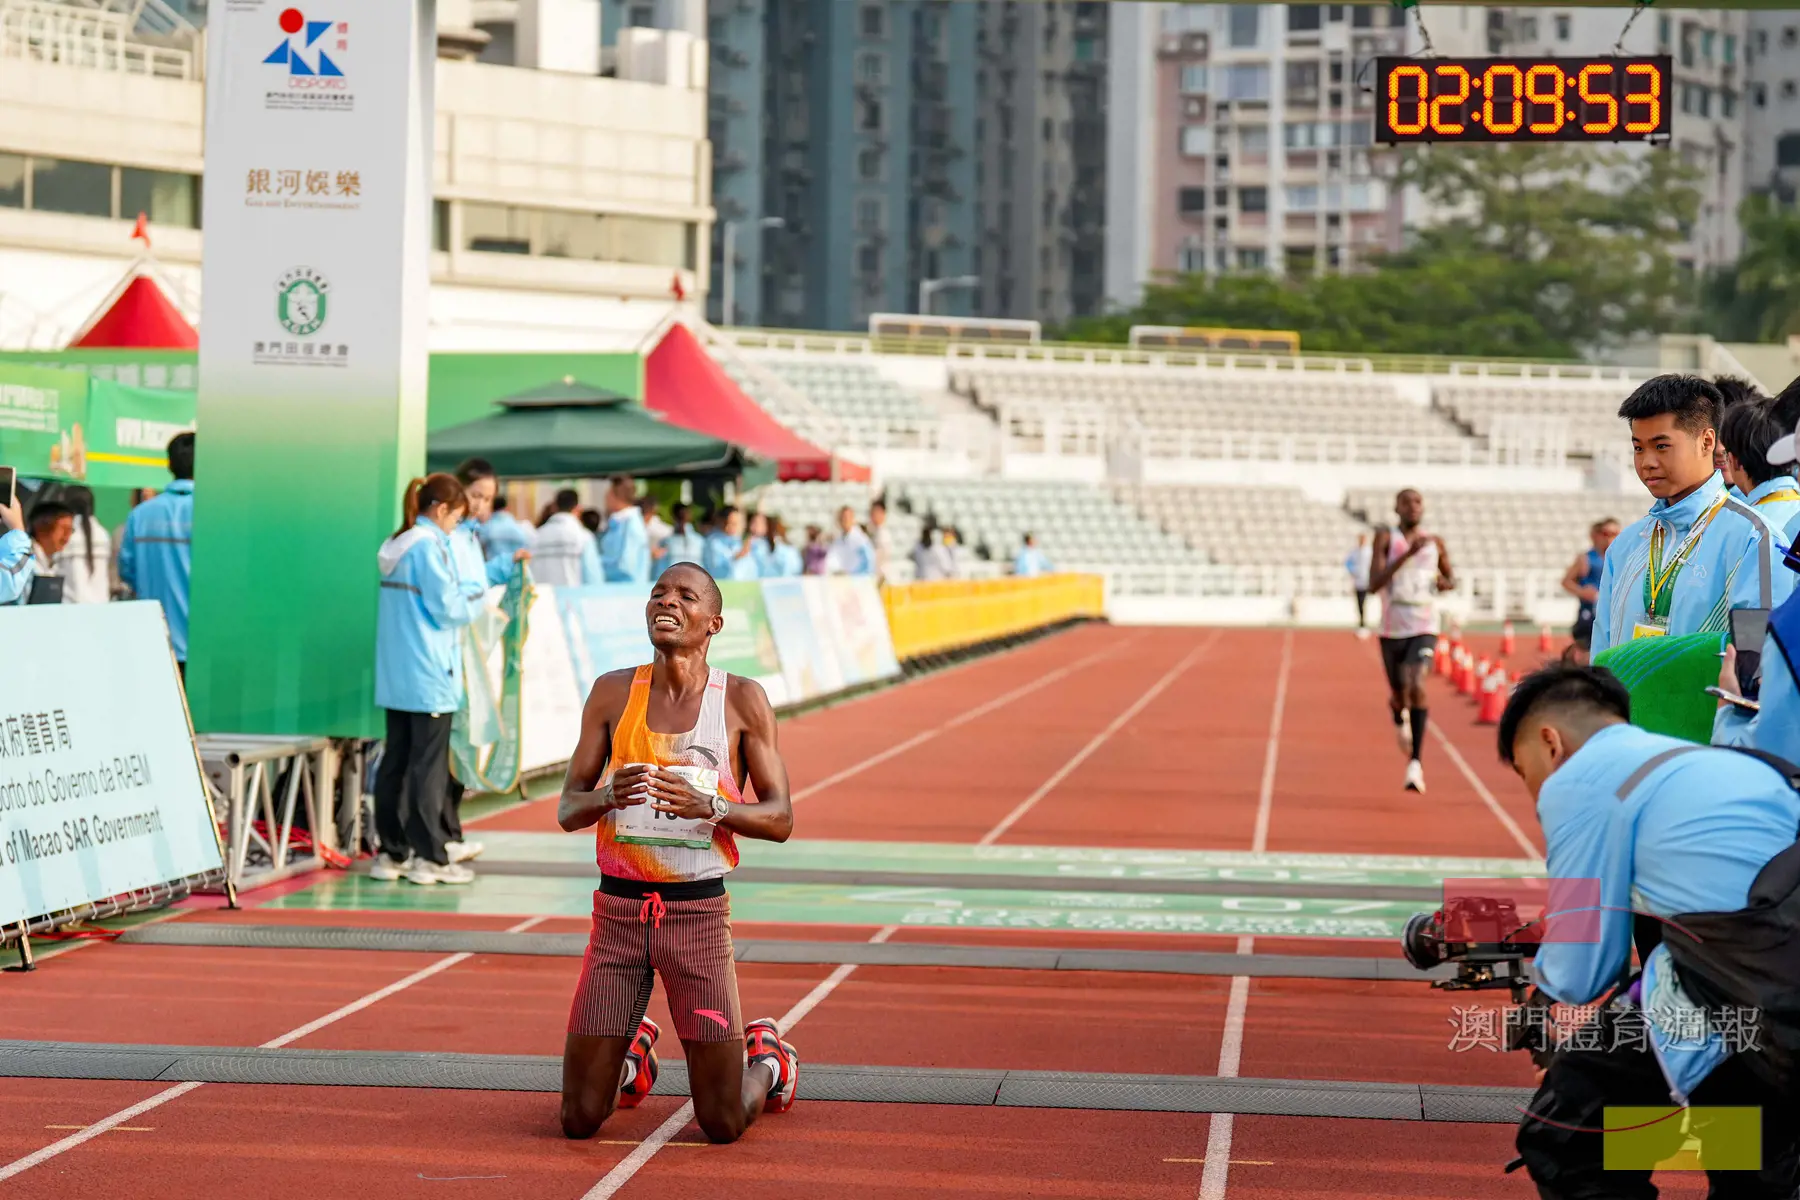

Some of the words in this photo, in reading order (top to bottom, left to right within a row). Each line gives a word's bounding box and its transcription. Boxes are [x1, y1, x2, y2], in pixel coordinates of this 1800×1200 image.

[1388, 64, 1661, 135] 02:09:53
[246, 169, 361, 197] 銀河娛樂
[28, 771, 45, 807] do
[45, 768, 98, 803] Governo
[100, 760, 115, 793] da
[114, 753, 152, 790] RAEM
[6, 830, 20, 864] of
[19, 828, 63, 862] Macao
[63, 817, 93, 852] SAR
[92, 805, 163, 845] Government
